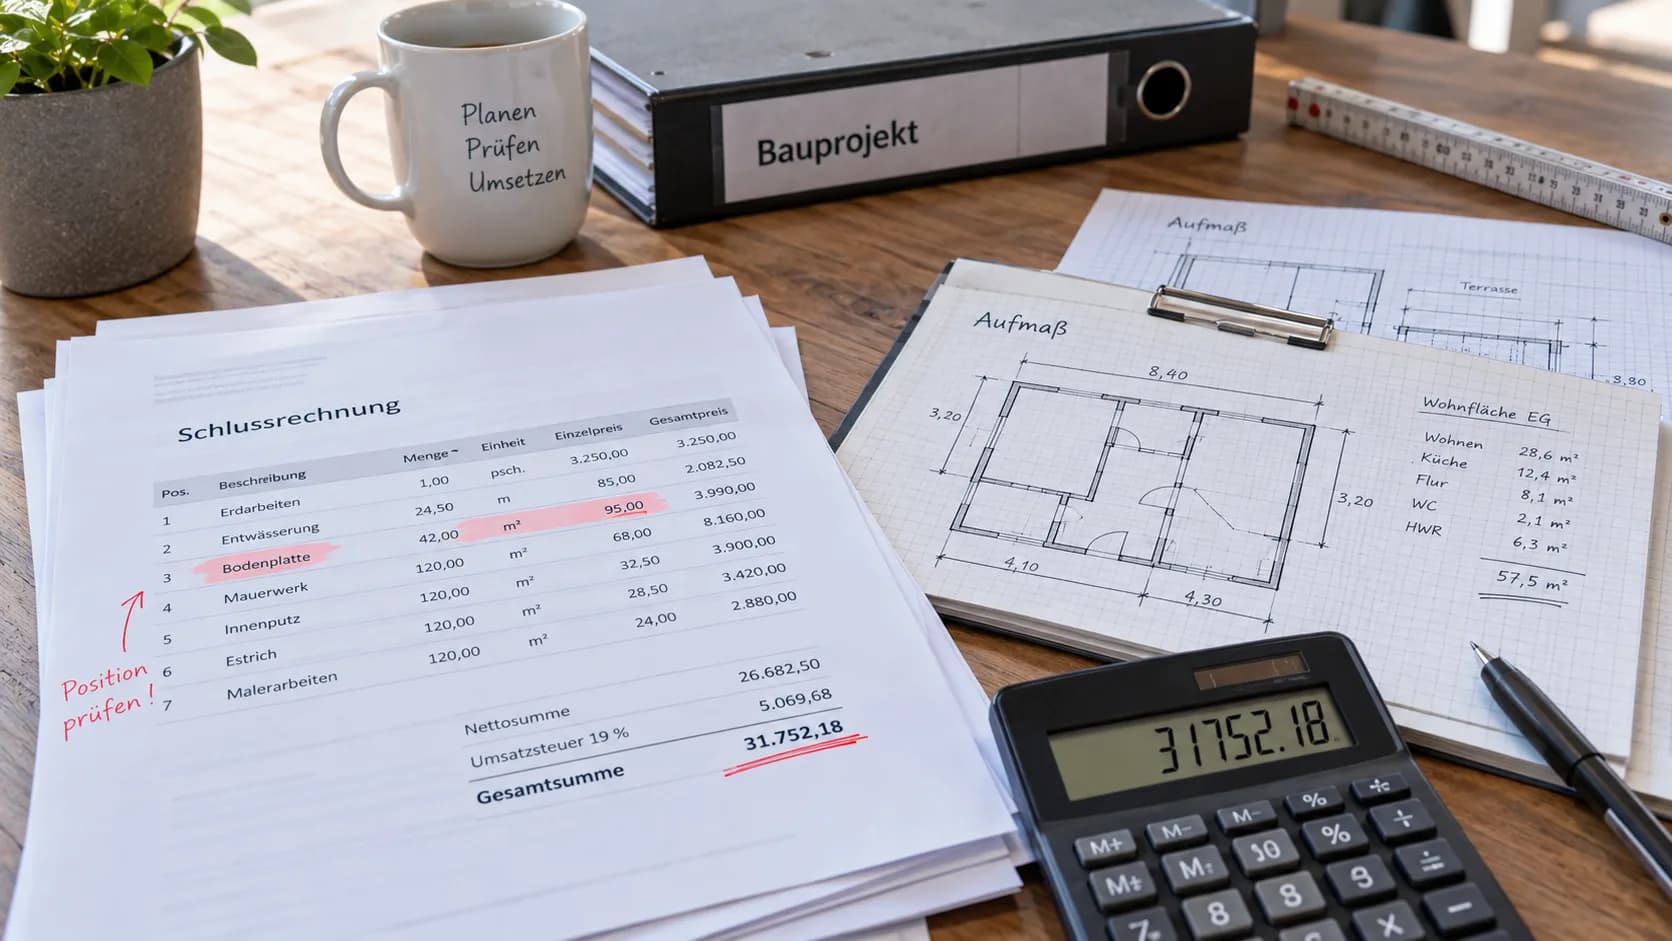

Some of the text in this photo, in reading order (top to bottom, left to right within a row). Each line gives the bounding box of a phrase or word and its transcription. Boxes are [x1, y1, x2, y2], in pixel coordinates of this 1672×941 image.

[460, 101, 537, 127] Planen
[465, 133, 541, 161] Prüfen
[757, 119, 919, 167] Bauprojekt
[469, 168, 567, 193] Umsetzen
[1167, 215, 1247, 236] Aufmaß
[1460, 281, 1518, 294] Terrasse
[973, 311, 1068, 340] Aufmaß
[1149, 365, 1188, 380] 8,40
[177, 400, 401, 443] Schlussrechnung
[929, 407, 962, 422] 3,20
[1423, 396, 1552, 427] Wohnfläche EG
[161, 488, 190, 499] Pos.
[219, 471, 307, 491] Beschreibung
[481, 437, 526, 452] Einheit
[554, 424, 624, 441] Einzelpreis
[649, 407, 729, 426] Gesamtpreis
[1425, 431, 1579, 463] Wohnen 28,6 m²
[162, 431, 737, 527] 1 Erdarbeiten 1,00 psch. 3.250,00 3.250,00
[1420, 451, 1577, 485] Küche 12,4 m²
[162, 456, 746, 555] 2 Entwässerung 24,50 m 85,00 2.082,50
[1336, 492, 1374, 508] 3,20
[1415, 473, 1574, 507] Flur 8,1 m²
[1412, 497, 1571, 529] WC 2,1 m²
[163, 481, 756, 584] 3 Bodenplatte 42,00 m² 95,00 3.990,00
[1405, 520, 1568, 554] HWR 6,3 m²
[162, 508, 766, 613] 4 Mauerwerk 120,00 m² 68,00 8.160,00
[1004, 556, 1039, 573] 4,10
[163, 535, 776, 645] 5 Innenputz 120,00 m² 32,50 3.900,00
[1496, 570, 1568, 592] 57,5 m²
[1184, 590, 1223, 607] 4,30
[162, 562, 787, 678] 6 Estrich 120,00 m² 28,50 3.420,00
[162, 590, 797, 712] 7 Malerarbeiten 120,00 m² 24,00 2.880,00
[61, 665, 148, 702] Position
[464, 658, 821, 736] Nettosumme 26.682,50
[63, 697, 142, 742] prüfen
[470, 688, 833, 769] Umsatzsteuer 19 % 5.069,68
[1154, 699, 1329, 775] 31752.18
[476, 720, 844, 805] Gesamtsumme 31.752,18
[1089, 837, 1123, 855] M+
[1279, 883, 1303, 908] 8
[1207, 901, 1230, 926] 8
